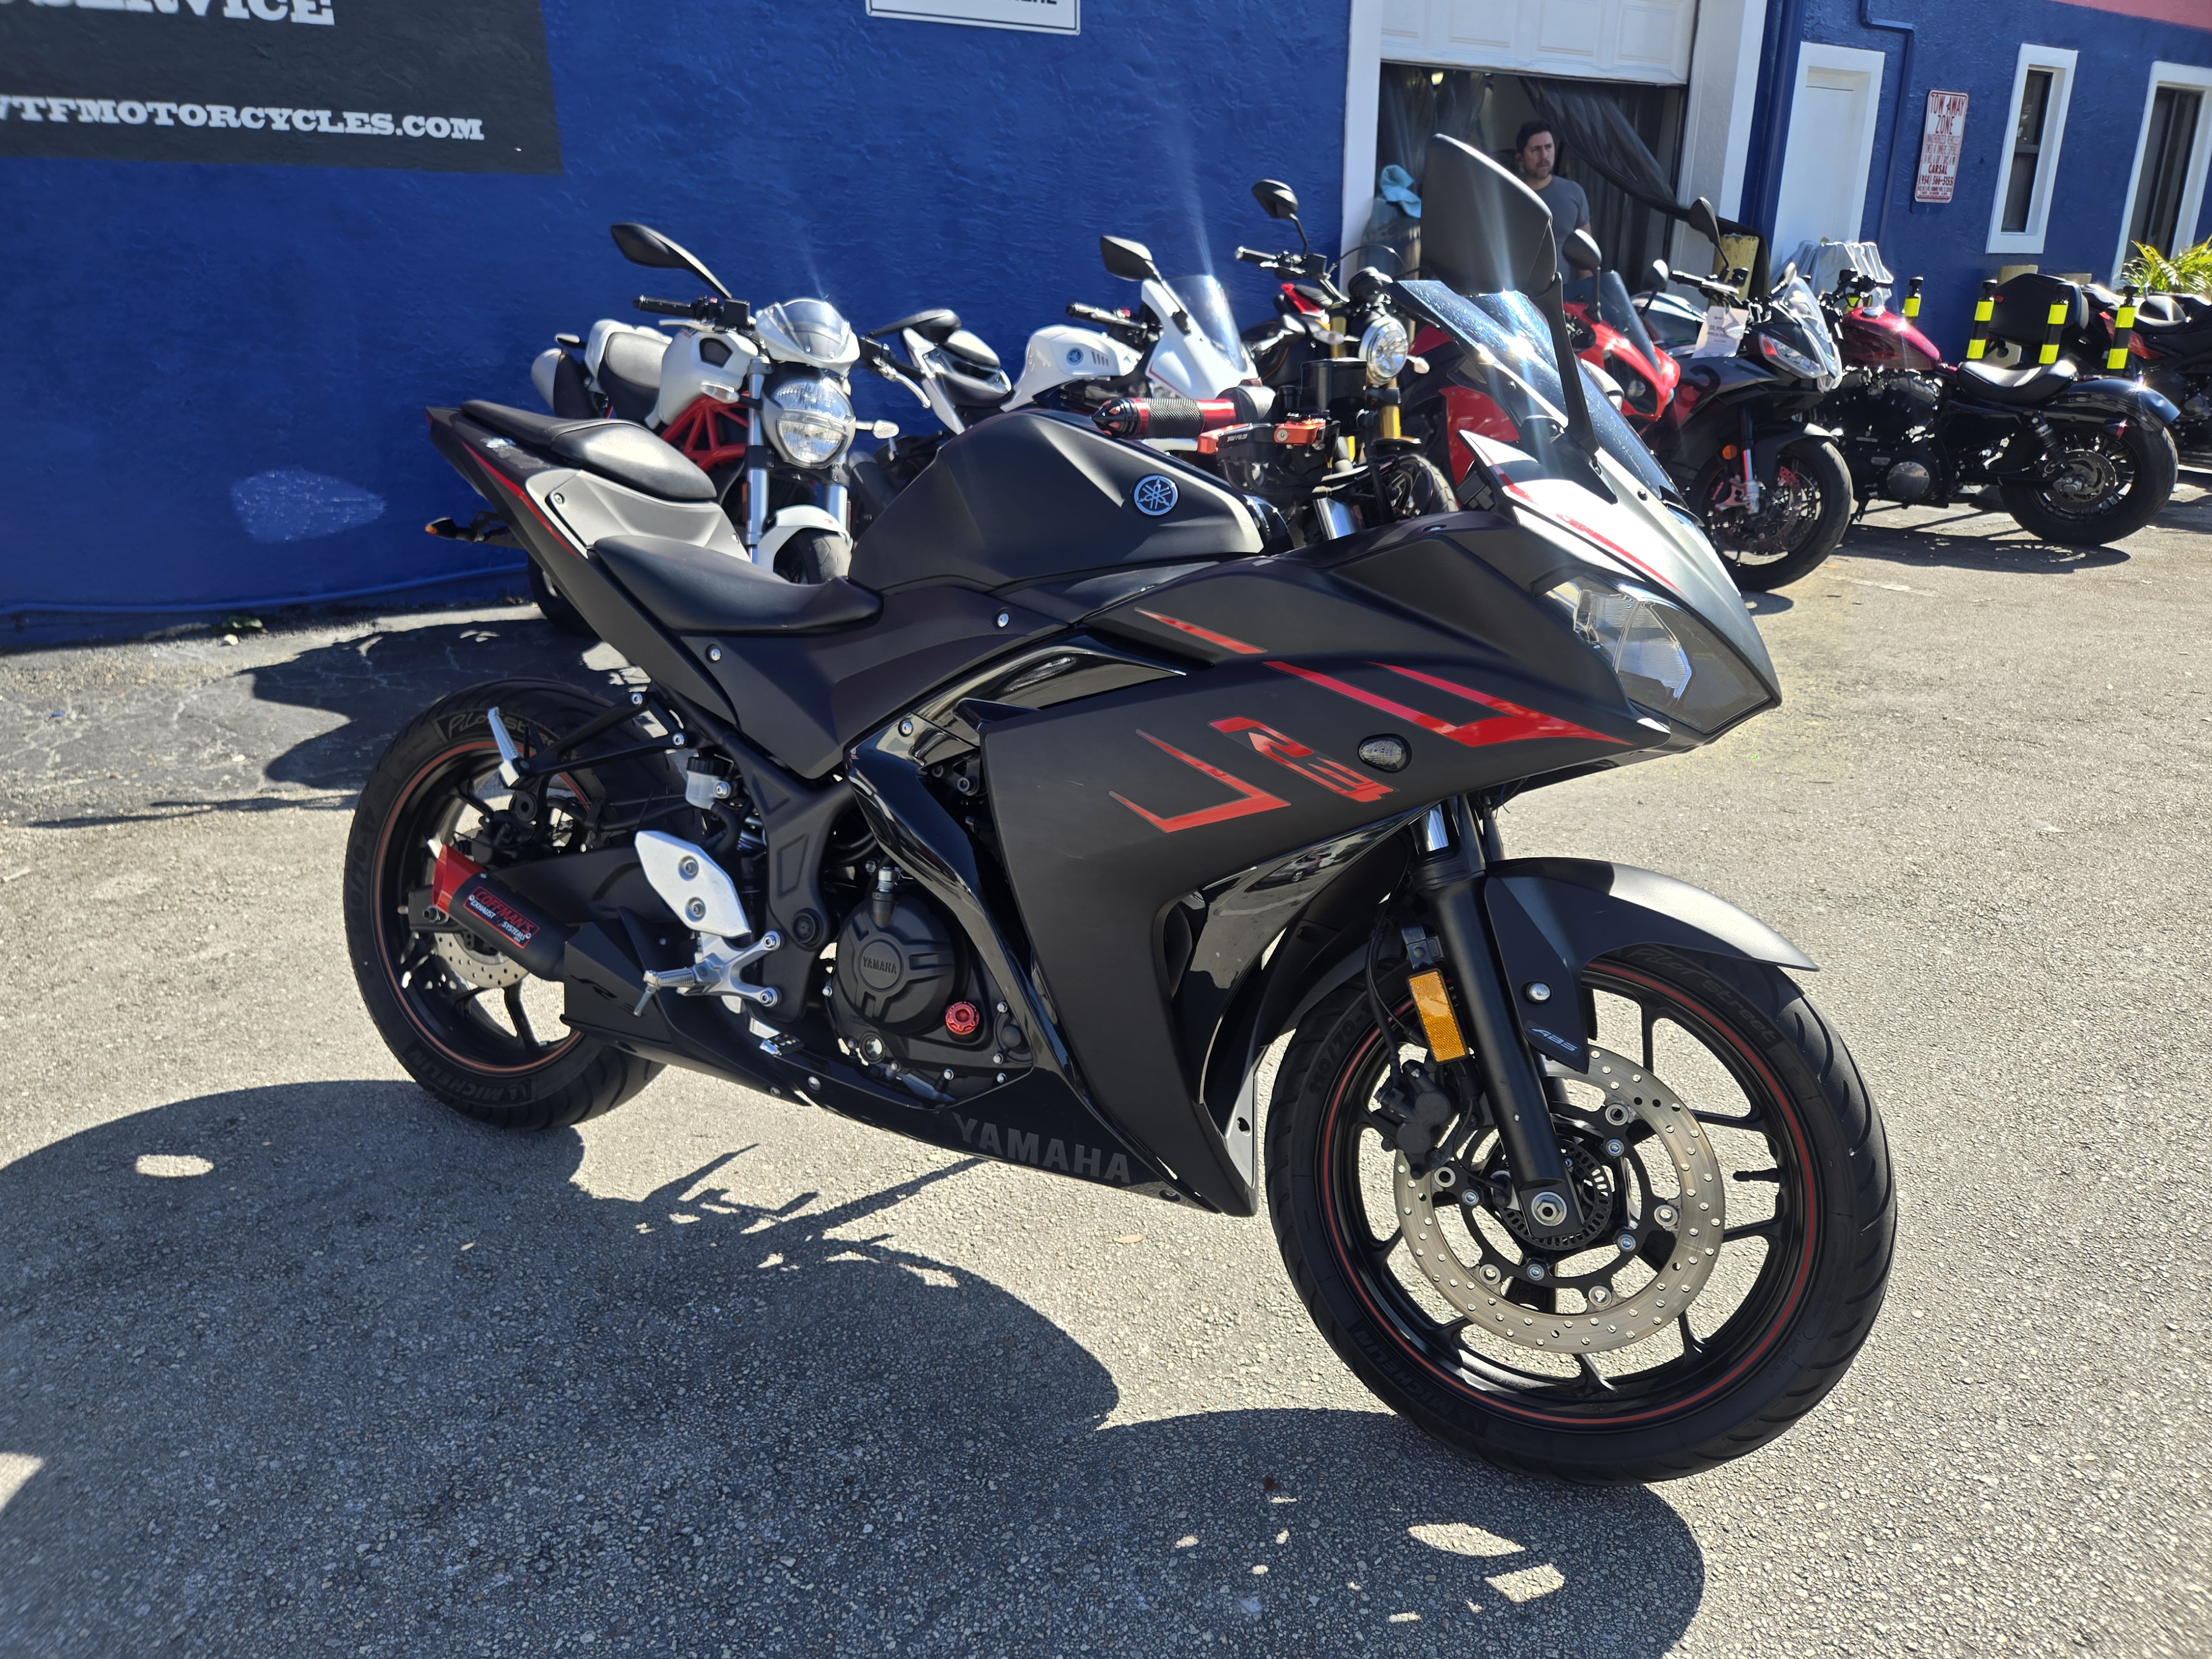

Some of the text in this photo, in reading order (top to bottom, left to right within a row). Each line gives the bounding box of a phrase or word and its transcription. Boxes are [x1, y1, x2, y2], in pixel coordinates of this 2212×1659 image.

[1931, 94, 1966, 117] TOW AWAY
[1936, 114, 1955, 135] ZONE
[1928, 164, 1947, 175] CARSAL
[470, 899, 497, 919] EXHAUST
[476, 891, 534, 935] COFFMAN'S
[501, 920, 526, 941] SYSTEMS
[863, 956, 896, 974] YAMAHA
[1531, 1028, 1578, 1051] ABS
[952, 1110, 1131, 1185] YAMAHA
